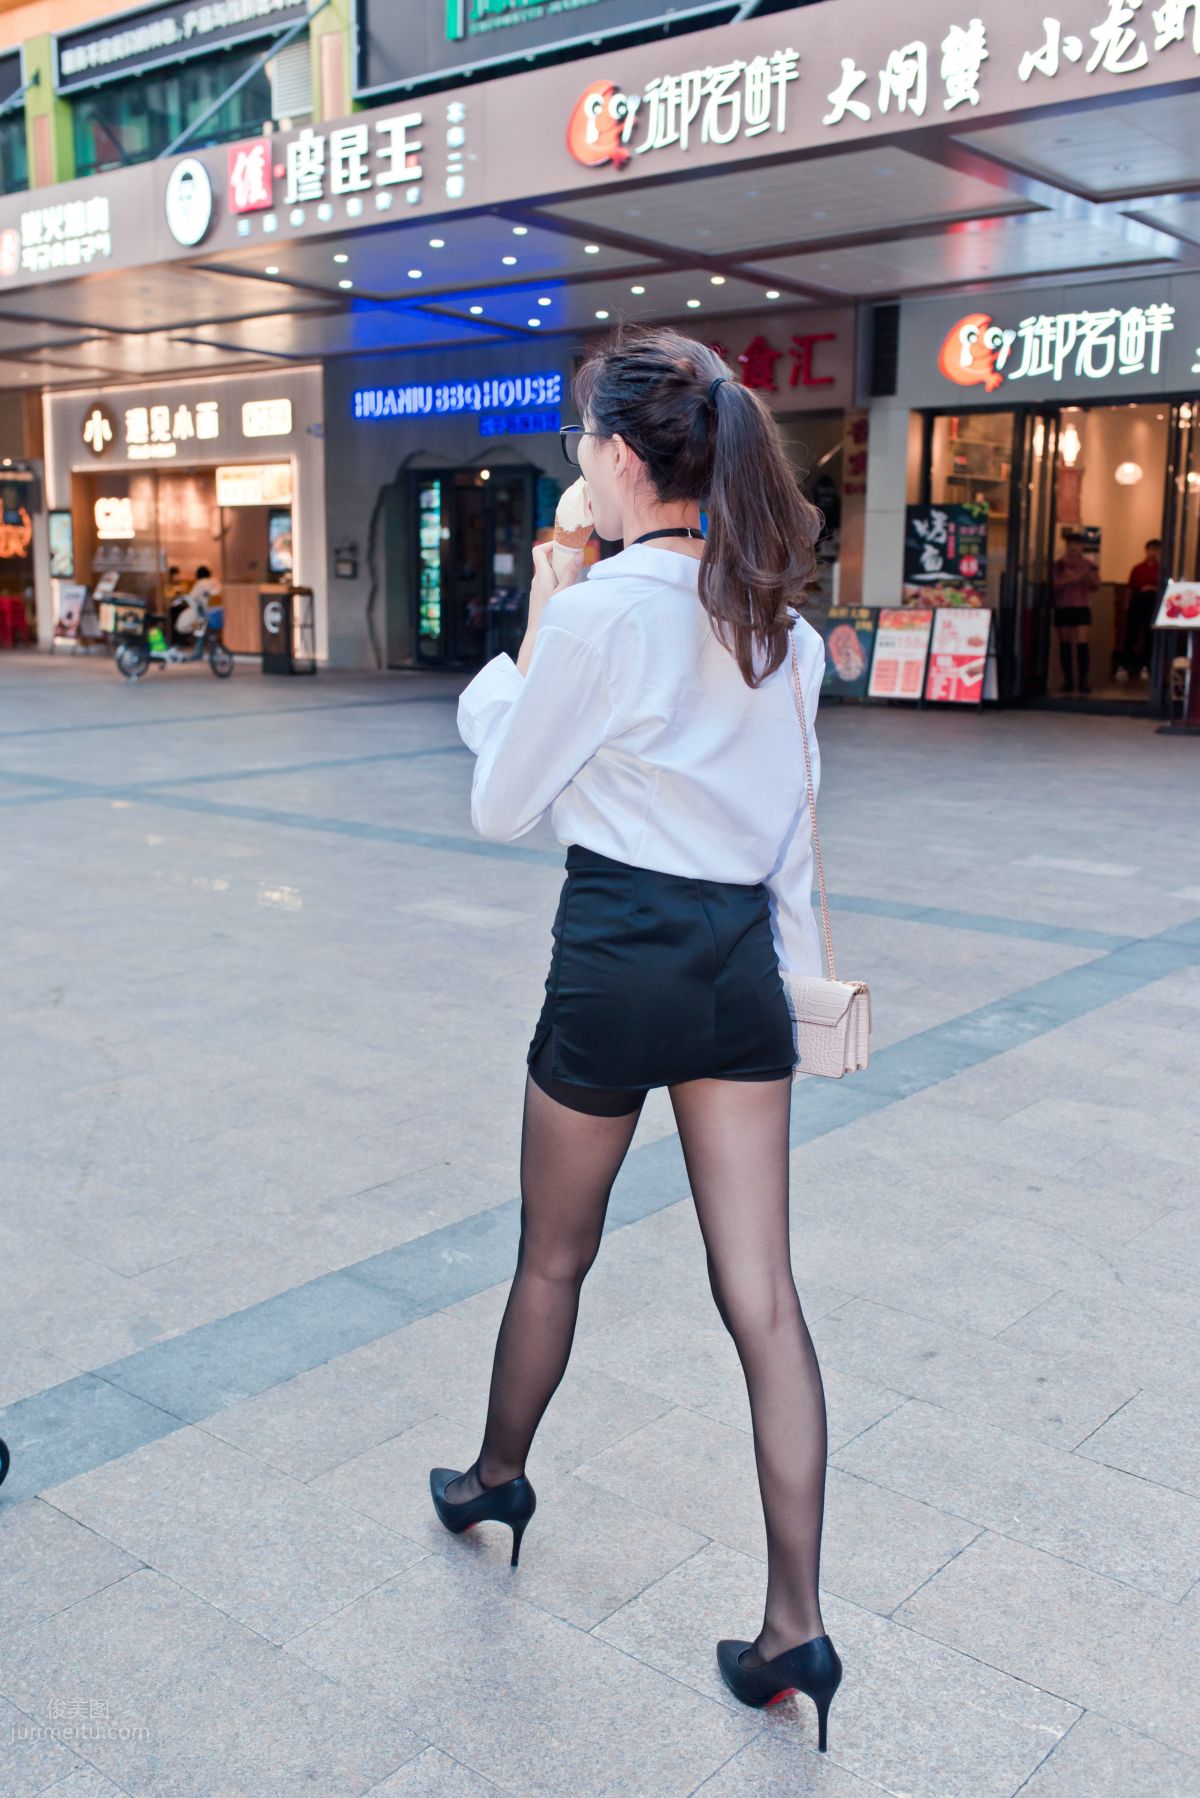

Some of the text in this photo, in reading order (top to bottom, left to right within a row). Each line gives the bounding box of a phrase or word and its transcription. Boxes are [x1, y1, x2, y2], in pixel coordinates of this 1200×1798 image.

[634, 47, 800, 154] 御茗鲜
[821, 17, 990, 126] 大闸蟹
[705, 332, 836, 392] 食汇
[1007, 302, 1176, 382] 御茗鲜
[434, 383, 481, 412] BBQ
[482, 374, 561, 408] HOUSE
